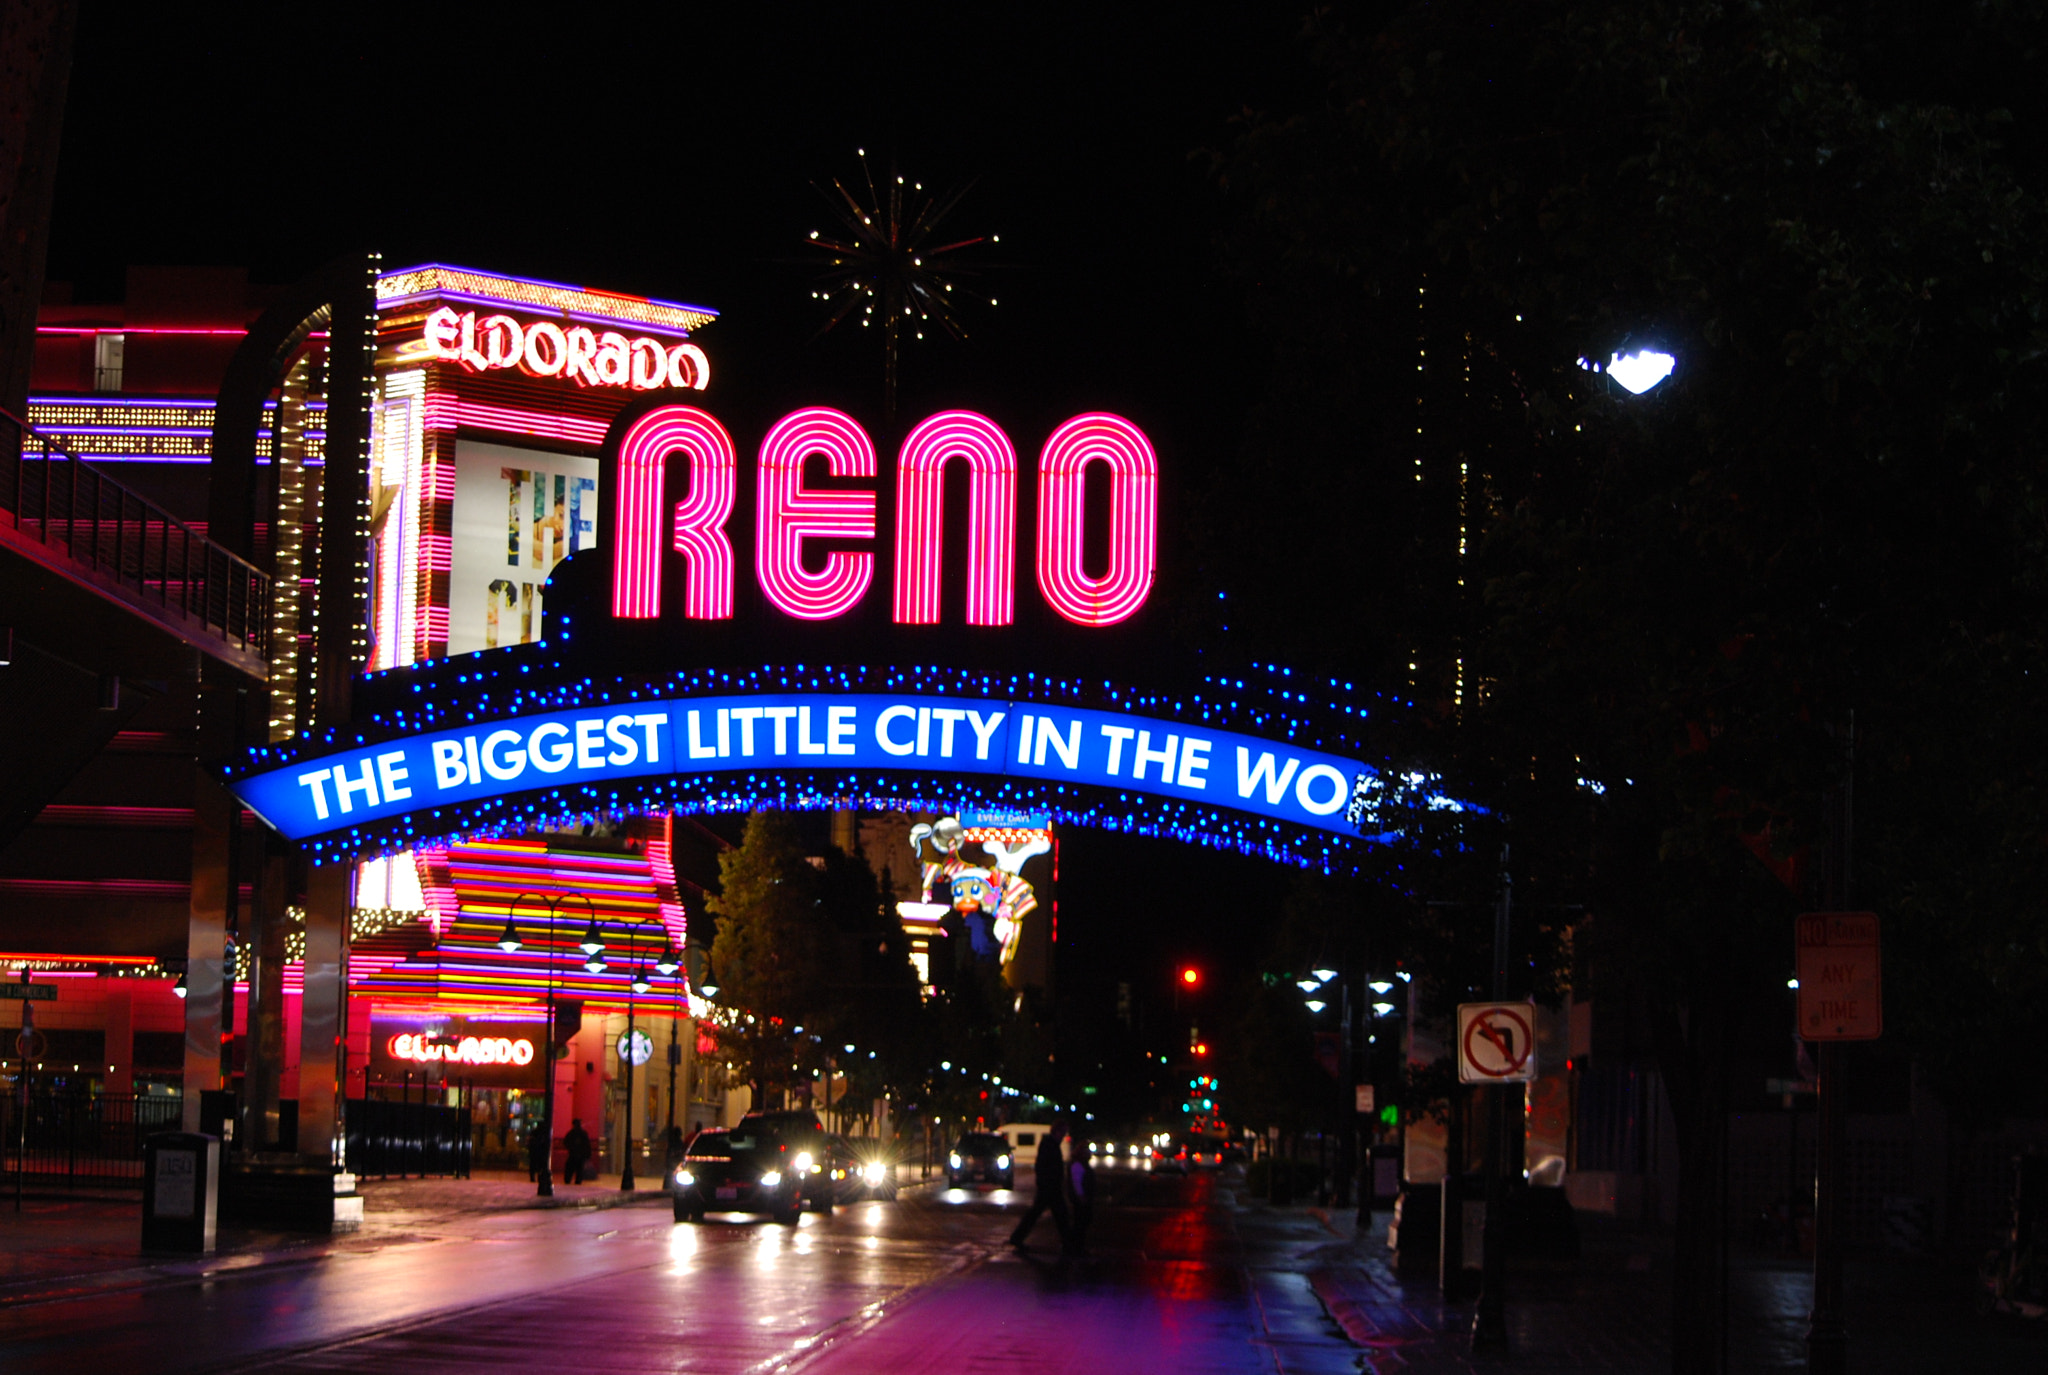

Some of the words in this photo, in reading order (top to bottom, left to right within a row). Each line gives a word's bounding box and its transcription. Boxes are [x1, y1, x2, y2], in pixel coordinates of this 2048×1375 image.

[424, 306, 710, 391] ELDORADO
[501, 466, 595, 569] THE
[612, 404, 1159, 628] RENO
[298, 750, 412, 820] THE
[432, 713, 668, 790] BIGGEST
[687, 706, 857, 759] LITTLE
[875, 705, 1006, 760] CITY
[1018, 715, 1083, 769] IN
[1101, 724, 1212, 789] THE
[1800, 919, 1824, 945] NO
[1821, 964, 1856, 984] ANY
[1820, 1000, 1859, 1020] TIME
